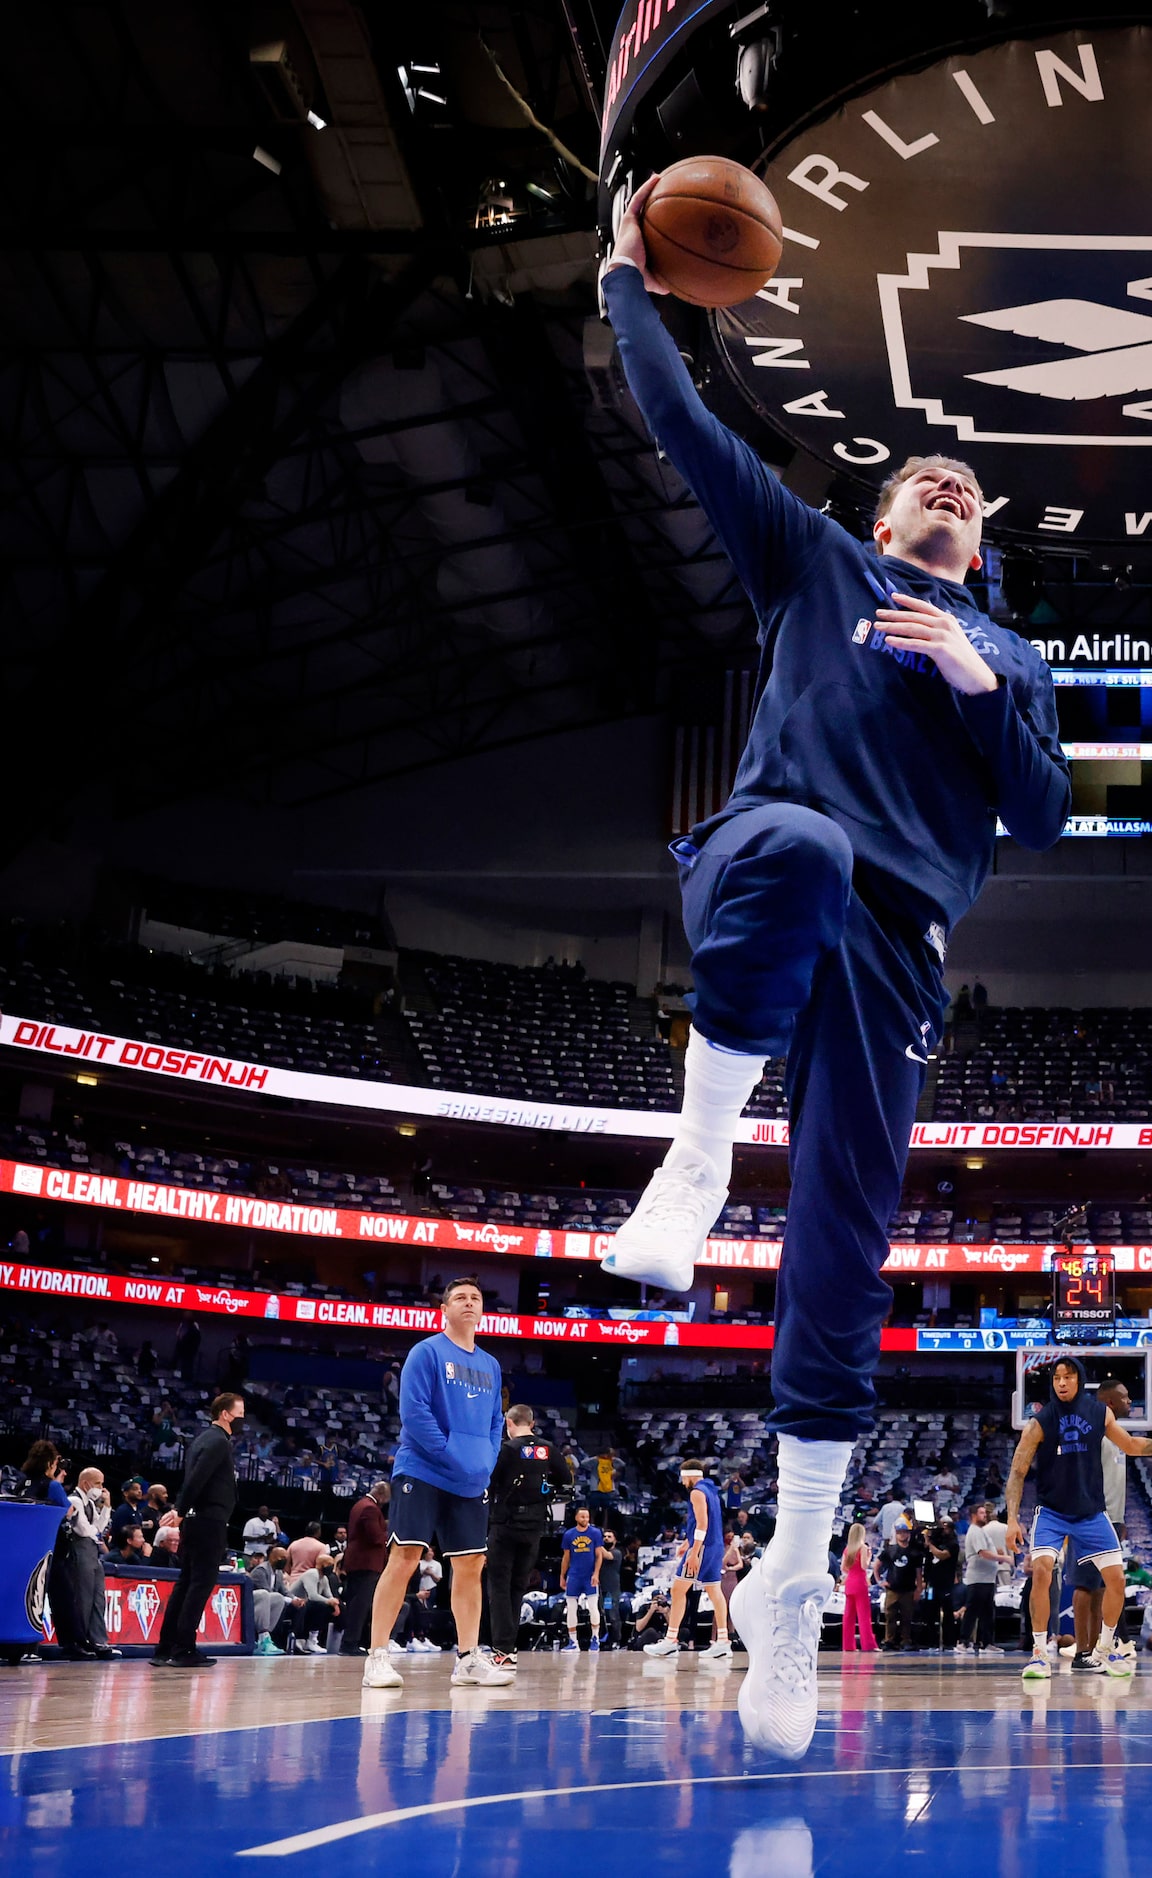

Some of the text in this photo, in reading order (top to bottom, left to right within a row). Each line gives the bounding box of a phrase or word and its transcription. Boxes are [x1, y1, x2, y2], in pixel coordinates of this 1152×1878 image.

[13, 1021, 115, 1059] DILJIT
[560, 1114, 607, 1132] LIVE
[752, 1124, 790, 1144] JUL 2
[911, 1126, 976, 1145] ILJIT
[46, 1170, 122, 1207] CLEAN.
[126, 1182, 221, 1220] HEALTHY.
[225, 1201, 343, 1236] HYDRATION.
[359, 1215, 411, 1239] NOW
[413, 1222, 439, 1242] AT
[886, 1249, 921, 1268] OW
[925, 1249, 949, 1267] AT
[18, 1267, 112, 1297] HYDRATION.
[124, 1282, 163, 1301] NOW
[165, 1287, 186, 1303] AT
[1066, 1278, 1103, 1305] 24
[318, 1302, 369, 1324] CLEAN.
[373, 1306, 438, 1329] HEALTHY.
[533, 1321, 568, 1337] NOW
[570, 1323, 588, 1338] AT
[1072, 1310, 1112, 1319] TISSOT
[963, 1339, 972, 1348] 0
